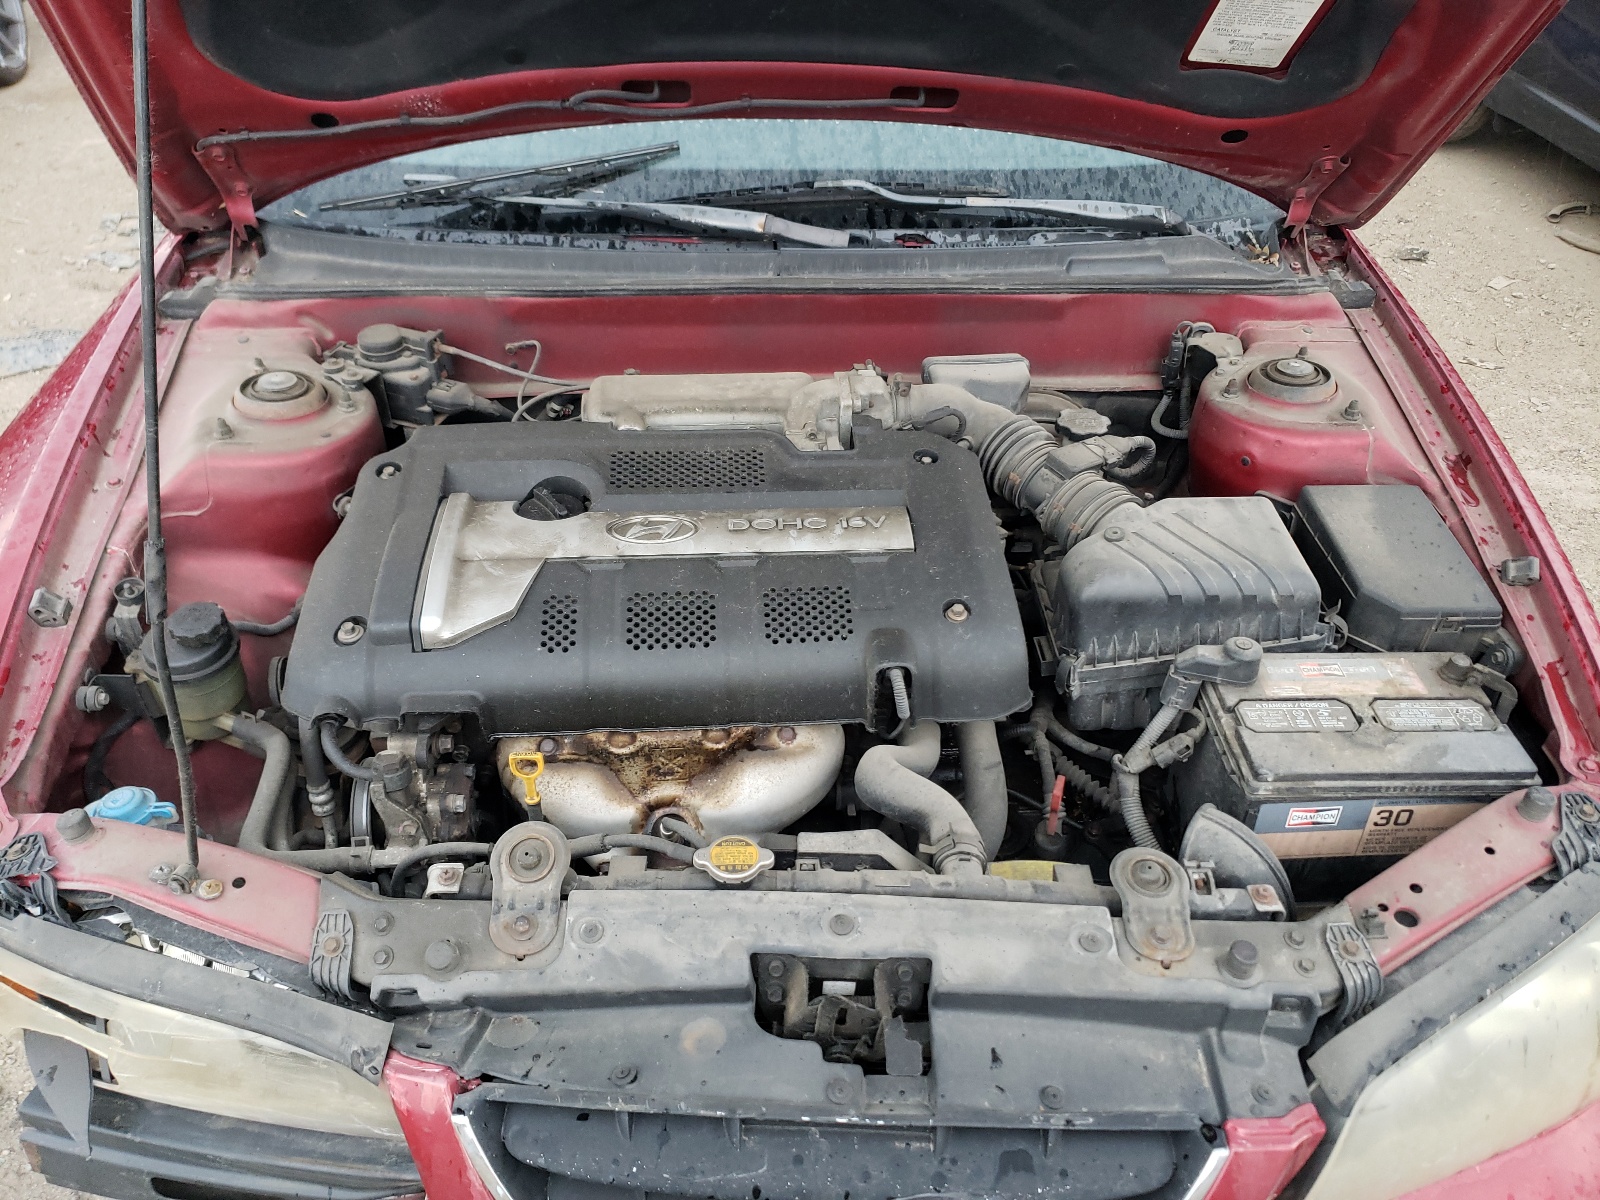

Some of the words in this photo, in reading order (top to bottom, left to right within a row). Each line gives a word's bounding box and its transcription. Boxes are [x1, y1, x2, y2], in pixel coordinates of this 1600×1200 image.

[727, 517, 828, 531] DOHC
[839, 514, 887, 529] 16V
[1291, 813, 1337, 821] CHAMPION
[1373, 808, 1414, 827] 30
